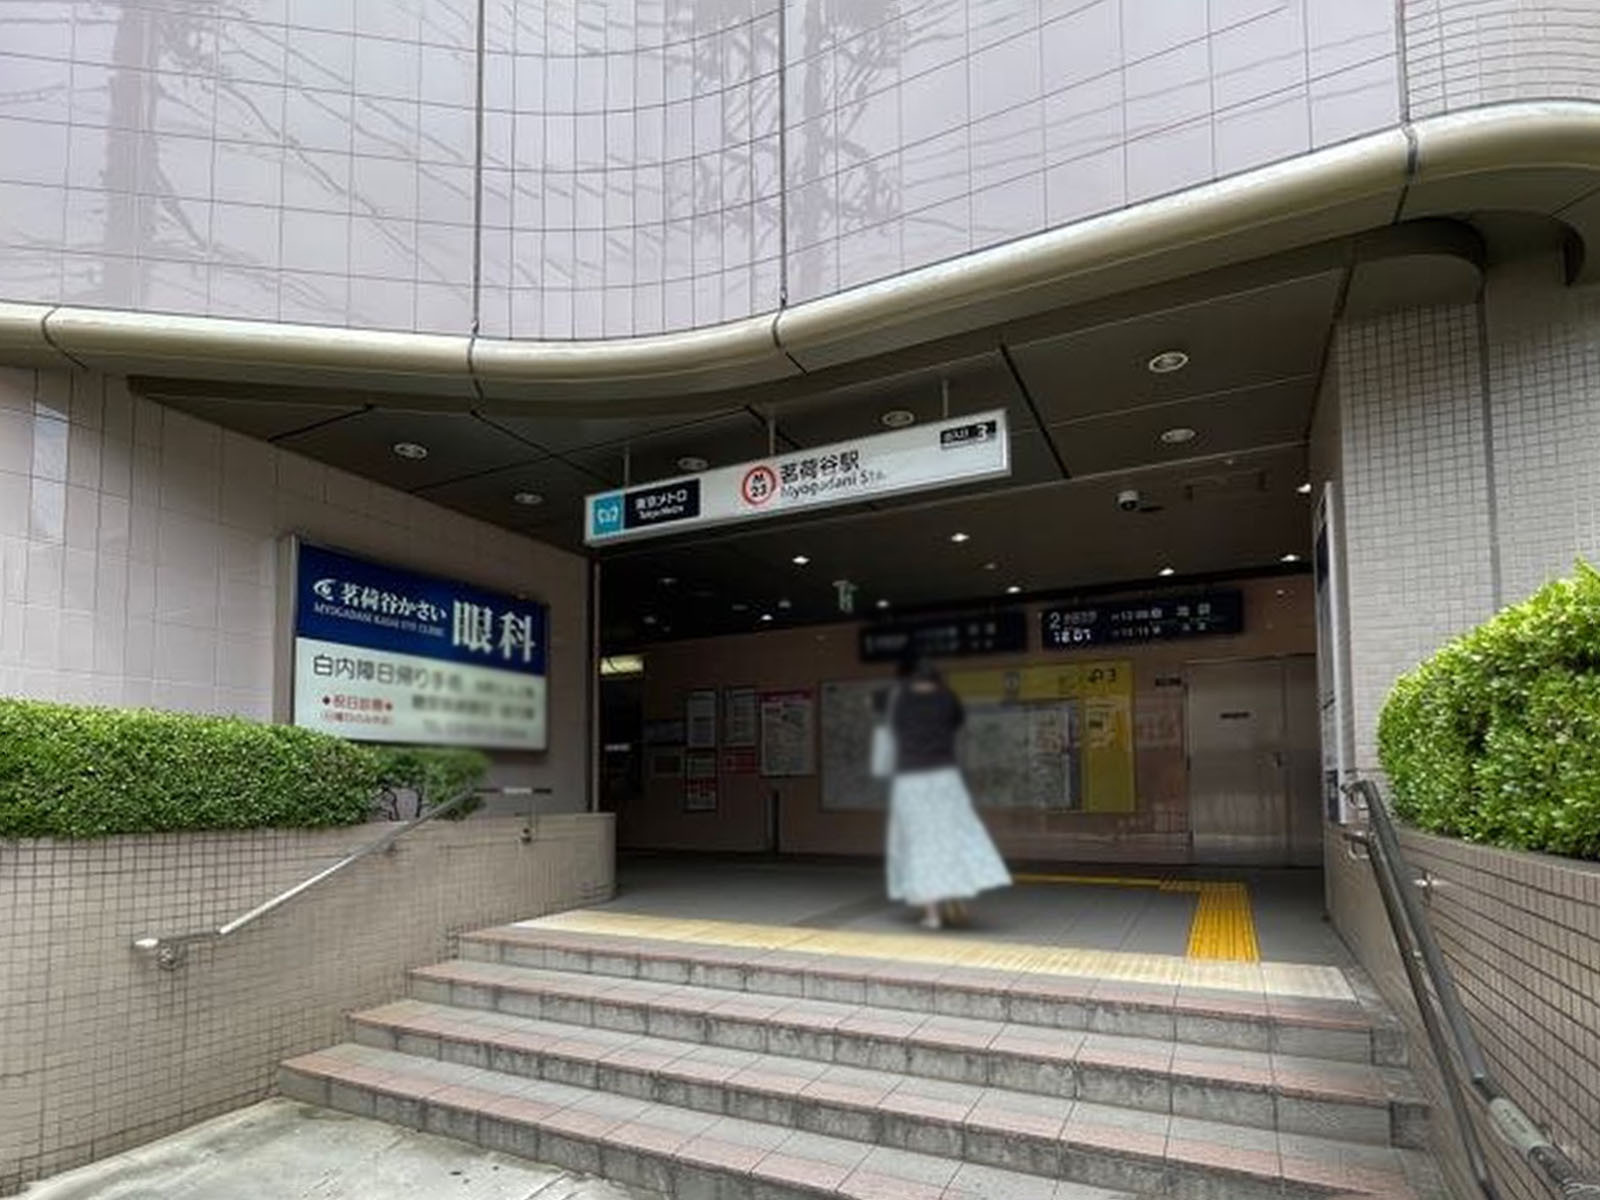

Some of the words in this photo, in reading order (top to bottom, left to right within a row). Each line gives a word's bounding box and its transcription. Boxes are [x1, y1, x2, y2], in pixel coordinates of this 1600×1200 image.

[977, 424, 988, 441] 3
[780, 450, 859, 484] 茗荷谷駅
[635, 489, 688, 509] 東京メトロ
[752, 484, 767, 497] 23
[341, 582, 447, 622] 茗荷谷かさい
[452, 599, 536, 663] 眼科
